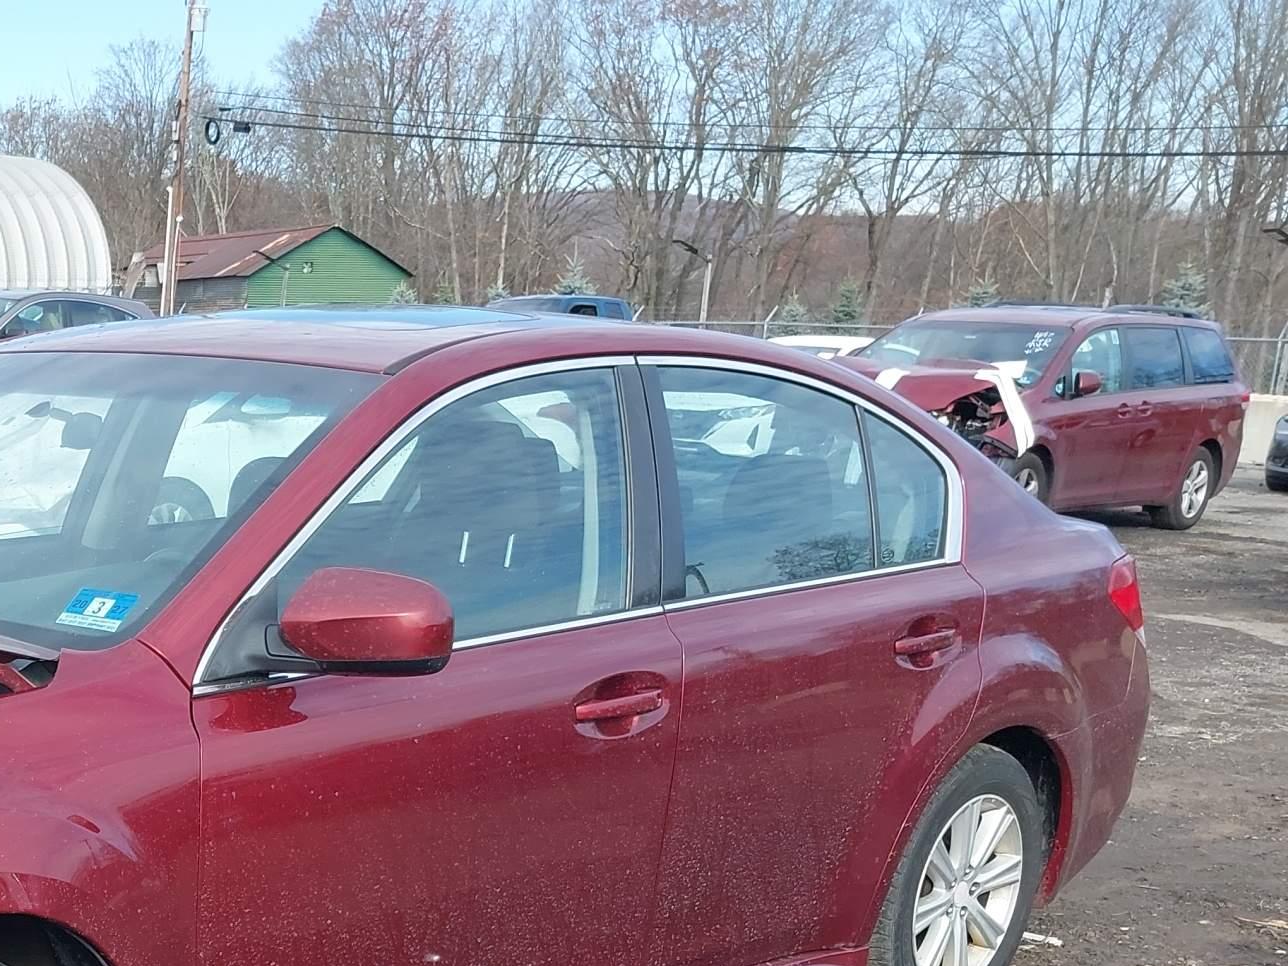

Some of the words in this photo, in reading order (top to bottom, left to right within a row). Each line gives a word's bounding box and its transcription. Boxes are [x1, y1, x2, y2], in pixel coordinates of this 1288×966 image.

[71, 599, 89, 609] 20
[91, 601, 106, 615] 3
[111, 605, 129, 617] 27
